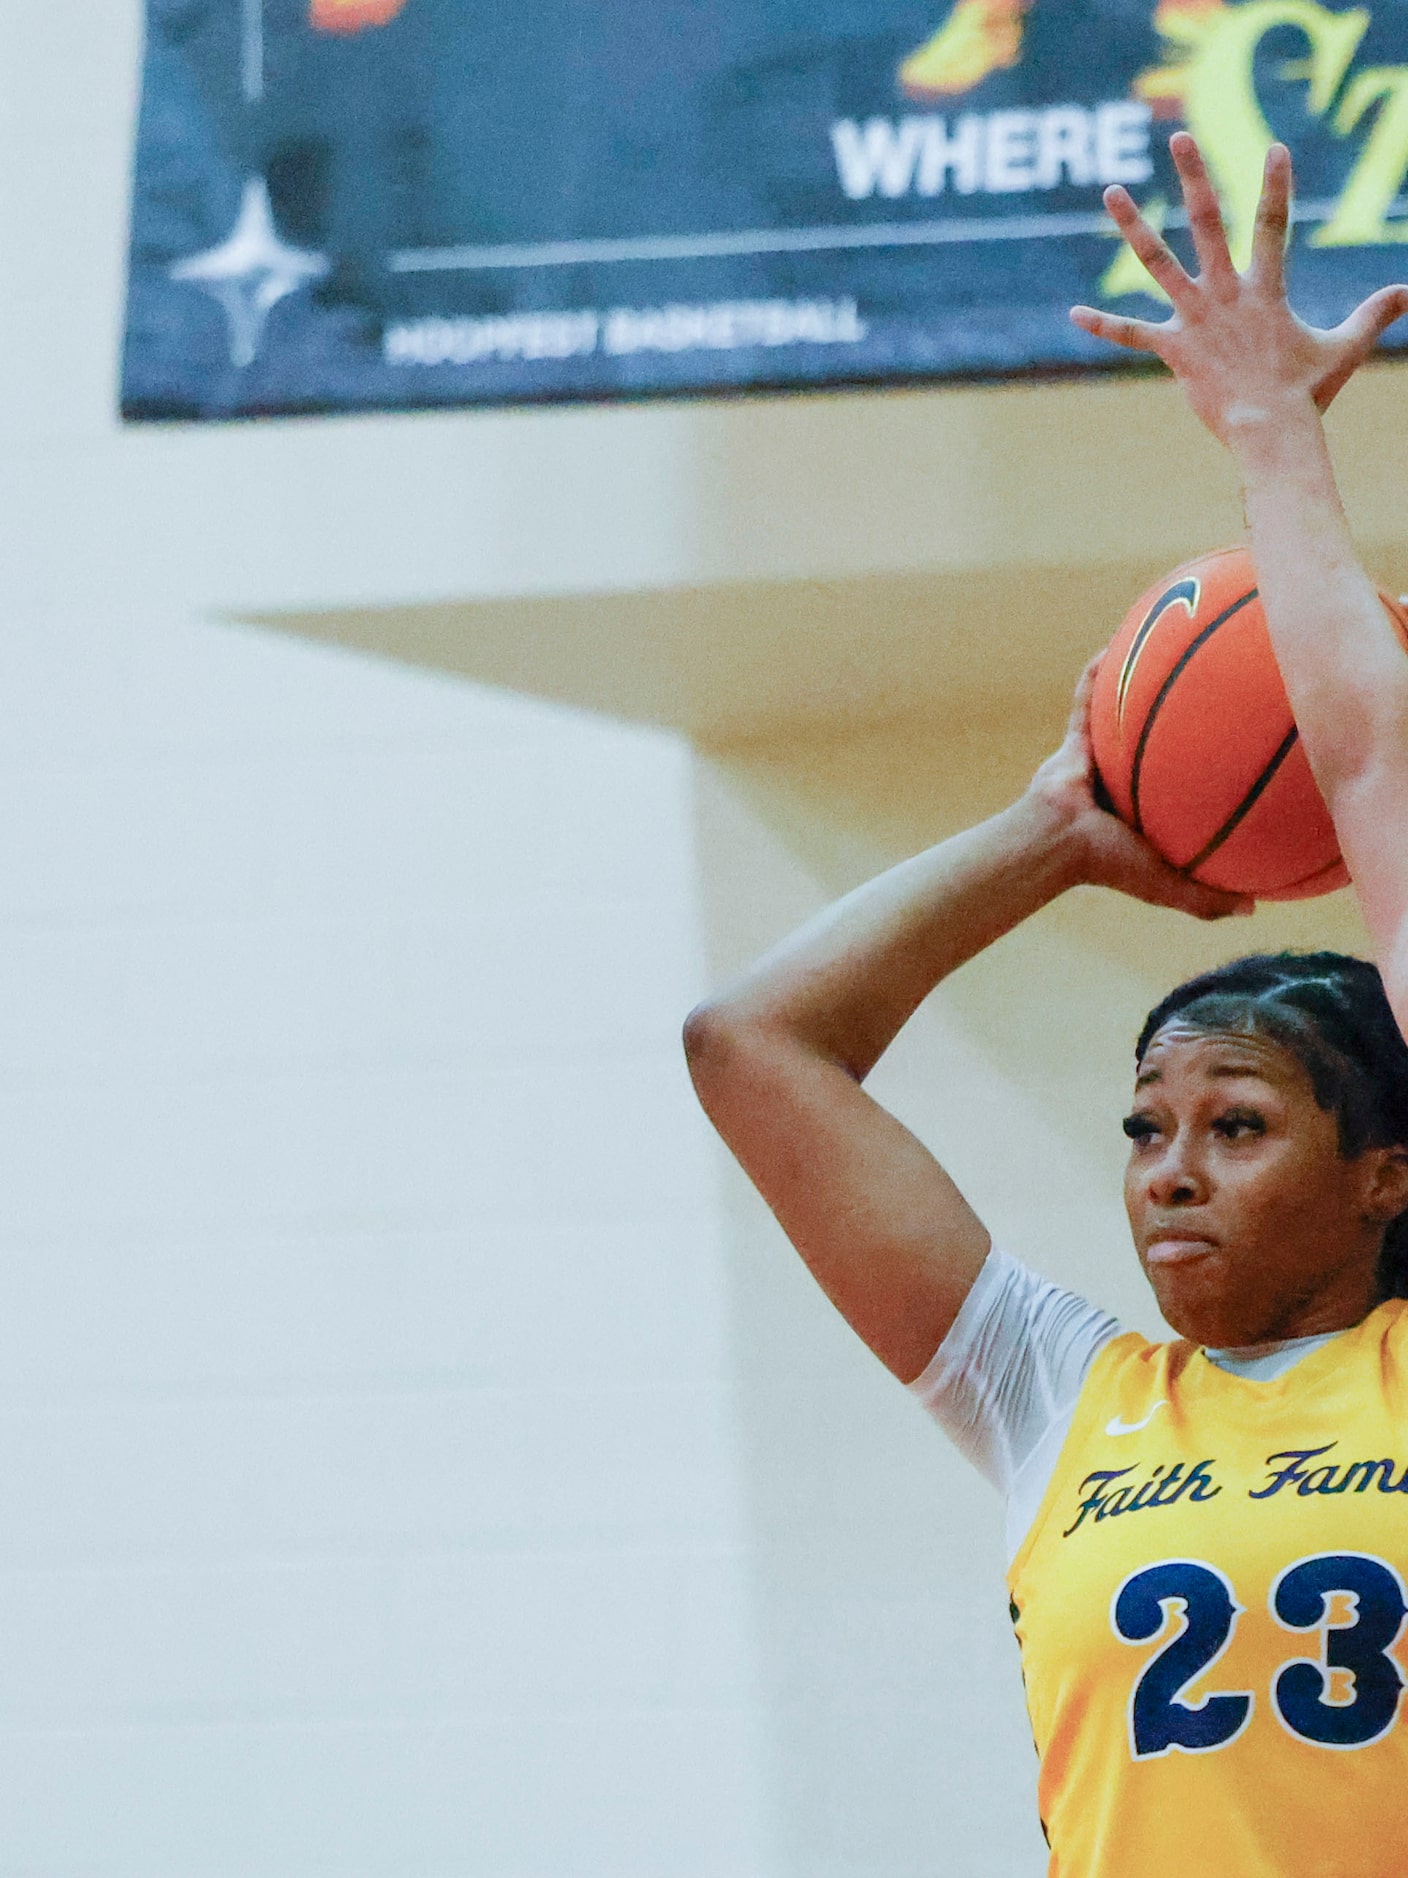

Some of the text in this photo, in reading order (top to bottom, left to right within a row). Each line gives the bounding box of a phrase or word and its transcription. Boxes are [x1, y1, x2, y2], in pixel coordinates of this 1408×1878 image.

[831, 102, 1154, 200] WHERE
[604, 298, 866, 354] BASKETBALL
[1062, 1458, 1222, 1538] Faith
